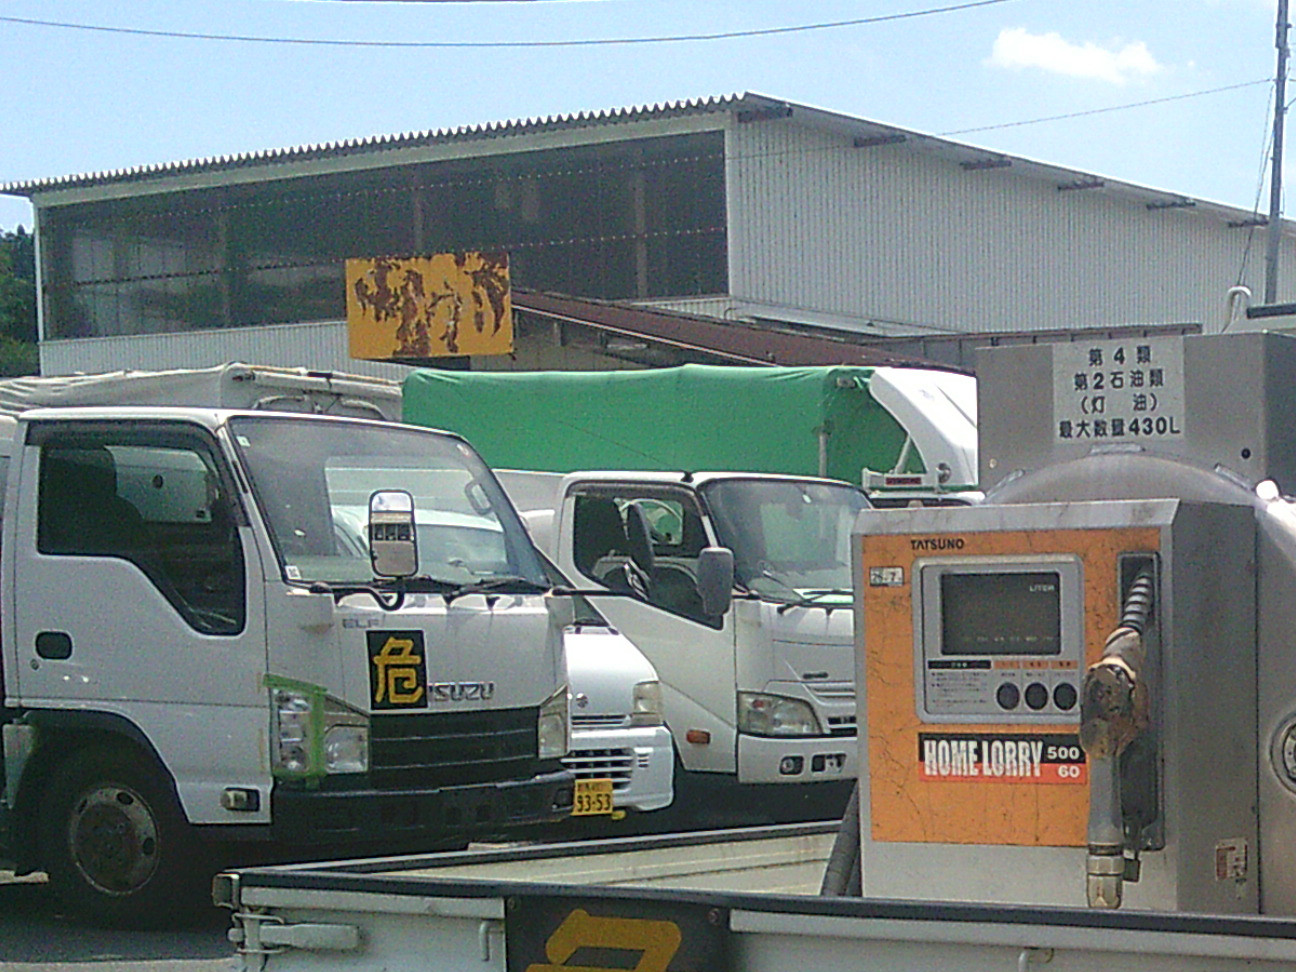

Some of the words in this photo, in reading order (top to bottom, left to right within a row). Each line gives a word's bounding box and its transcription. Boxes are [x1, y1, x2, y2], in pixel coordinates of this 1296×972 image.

[1089, 345, 1151, 366] 第4類
[1074, 368, 1163, 391] 第2石油類
[1059, 416, 1181, 438] 最大数量430L
[911, 538, 965, 550] TATSUNO
[373, 636, 424, 703] 危
[923, 739, 979, 776] HOME
[982, 740, 1043, 777] LORRY
[1047, 746, 1080, 760] 500
[1057, 765, 1080, 778] 60
